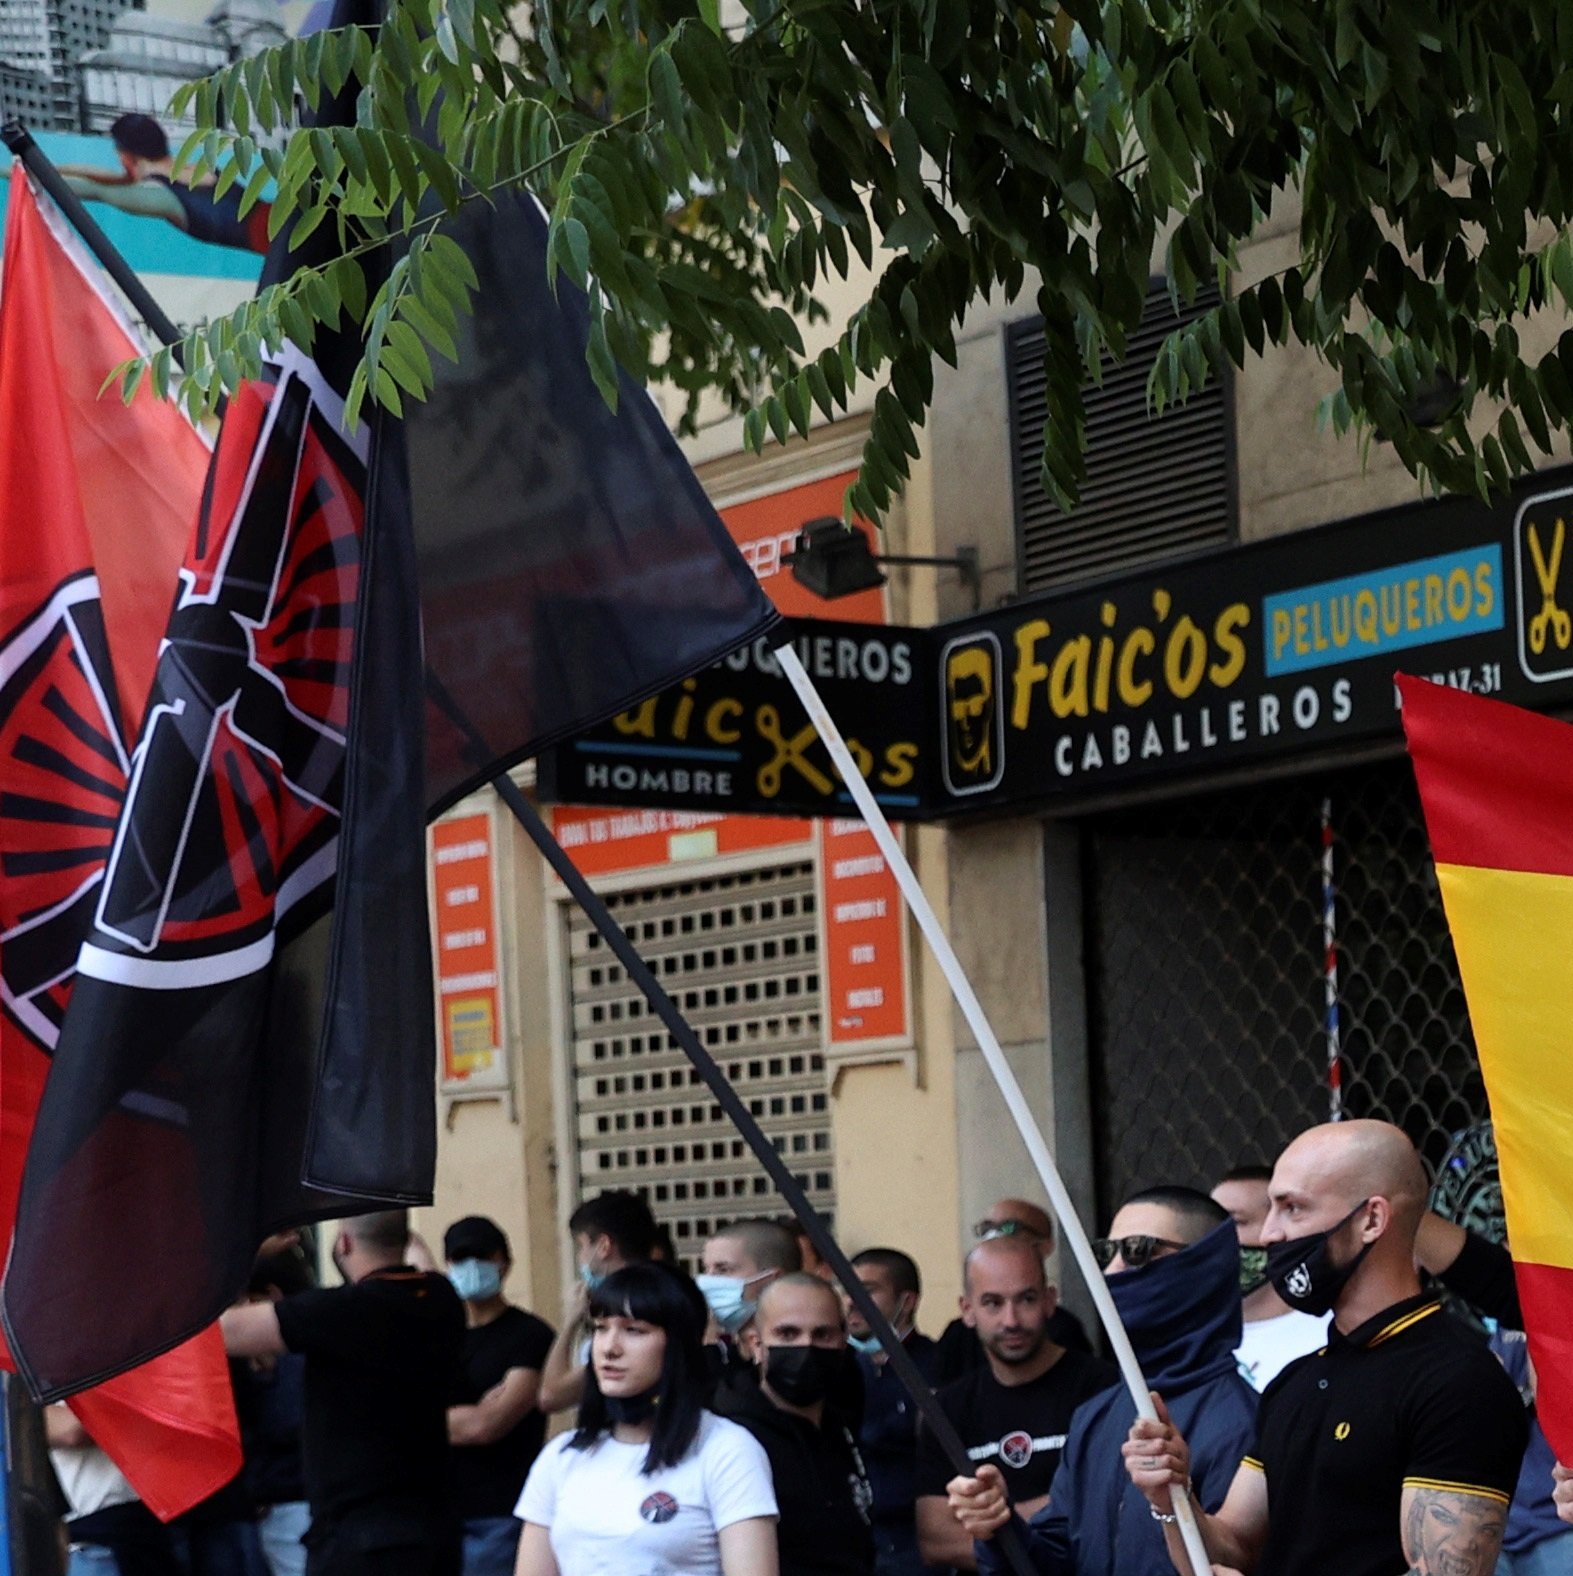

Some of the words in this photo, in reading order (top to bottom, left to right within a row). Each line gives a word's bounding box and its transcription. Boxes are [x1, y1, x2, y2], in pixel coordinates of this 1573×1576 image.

[1271, 561, 1495, 660] PELUQUEROS
[712, 635, 913, 685] UQUEROS
[610, 677, 746, 744] aic
[1054, 678, 1353, 777] CABALLEROS
[585, 761, 734, 797] HOMBRE
